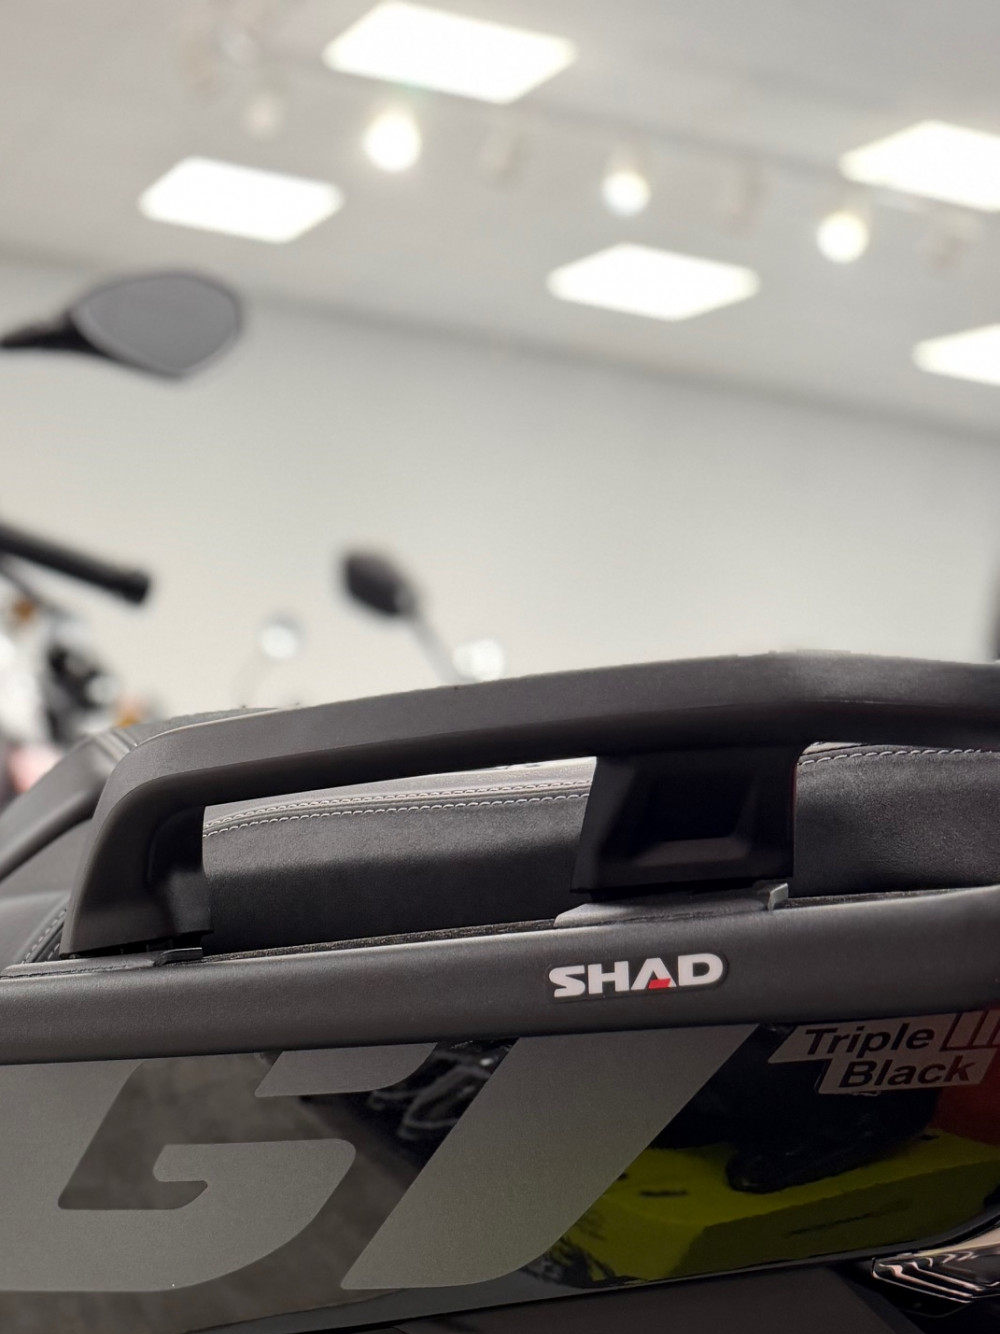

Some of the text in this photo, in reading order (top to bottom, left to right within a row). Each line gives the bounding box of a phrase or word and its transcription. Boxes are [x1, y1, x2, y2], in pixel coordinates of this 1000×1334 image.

[548, 952, 725, 999] SHAD
[804, 1022, 936, 1059] Triple
[838, 1055, 977, 1089] Black
